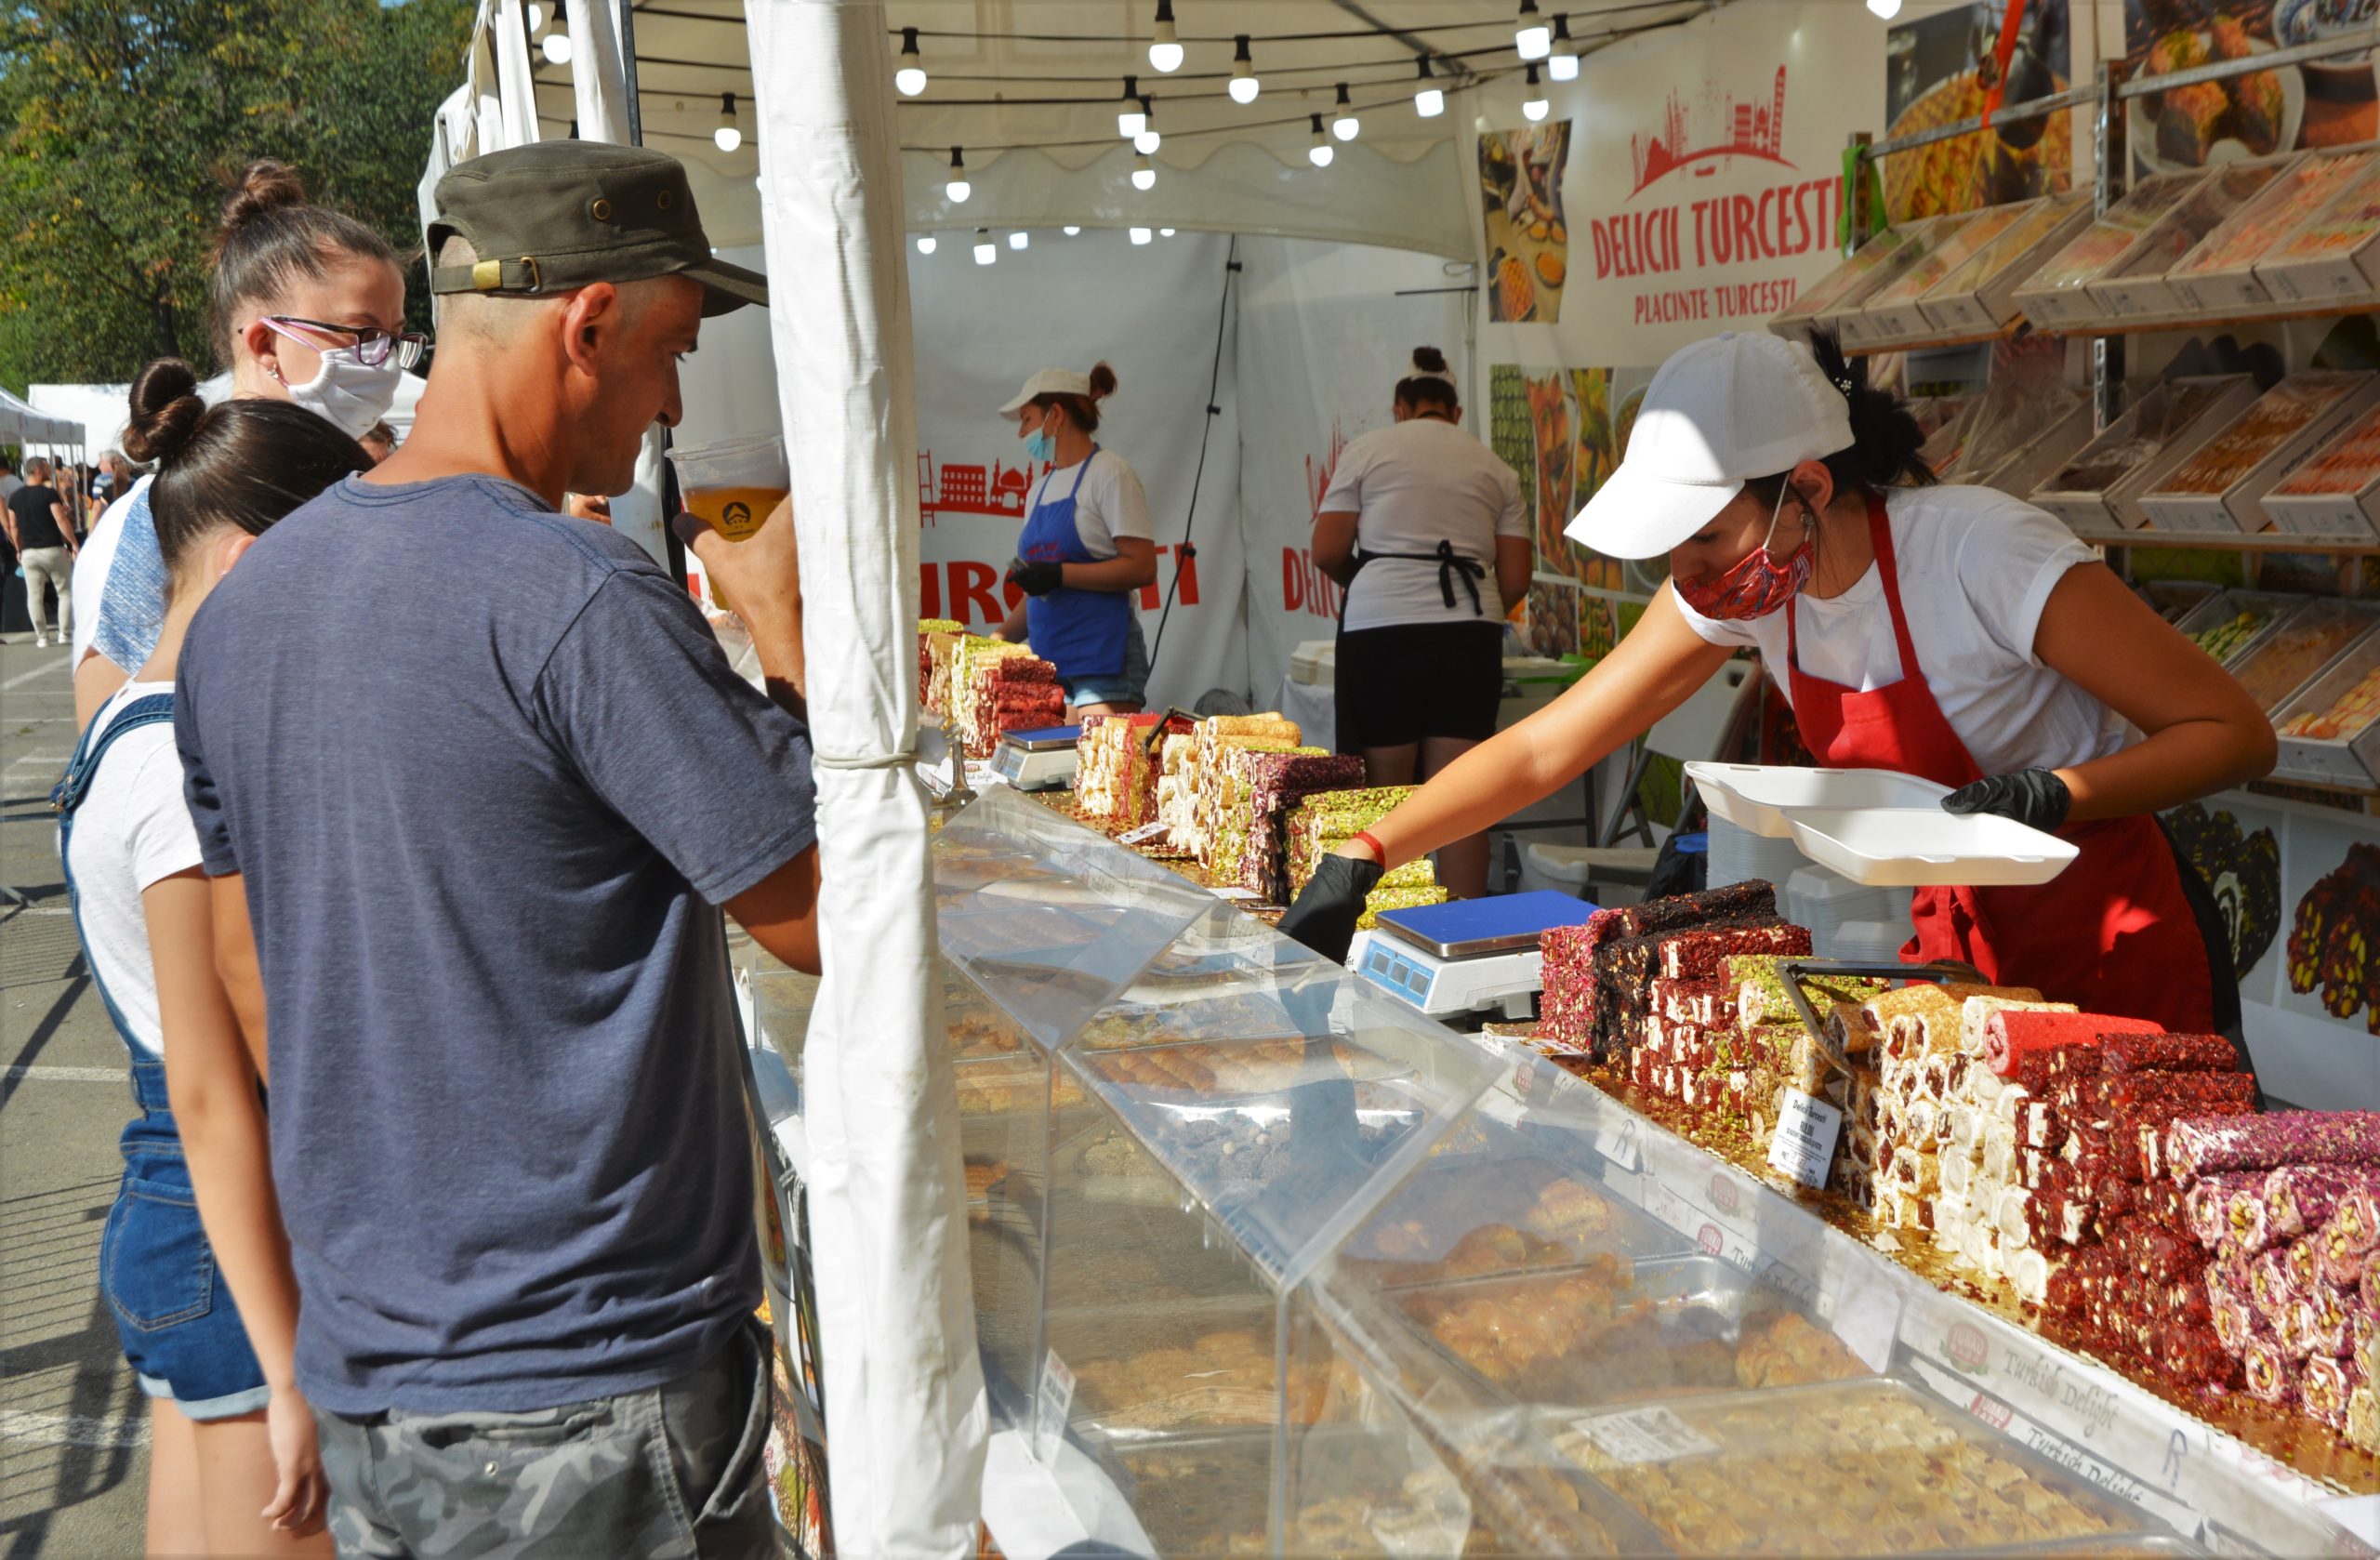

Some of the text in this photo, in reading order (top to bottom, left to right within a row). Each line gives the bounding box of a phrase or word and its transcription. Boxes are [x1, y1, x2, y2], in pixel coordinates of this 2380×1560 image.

[1591, 175, 1844, 280] DELICII TURCESTI
[1634, 278, 1796, 324] PLACINTE TURCESTI
[2003, 1349, 2120, 1438] Turkish Delight
